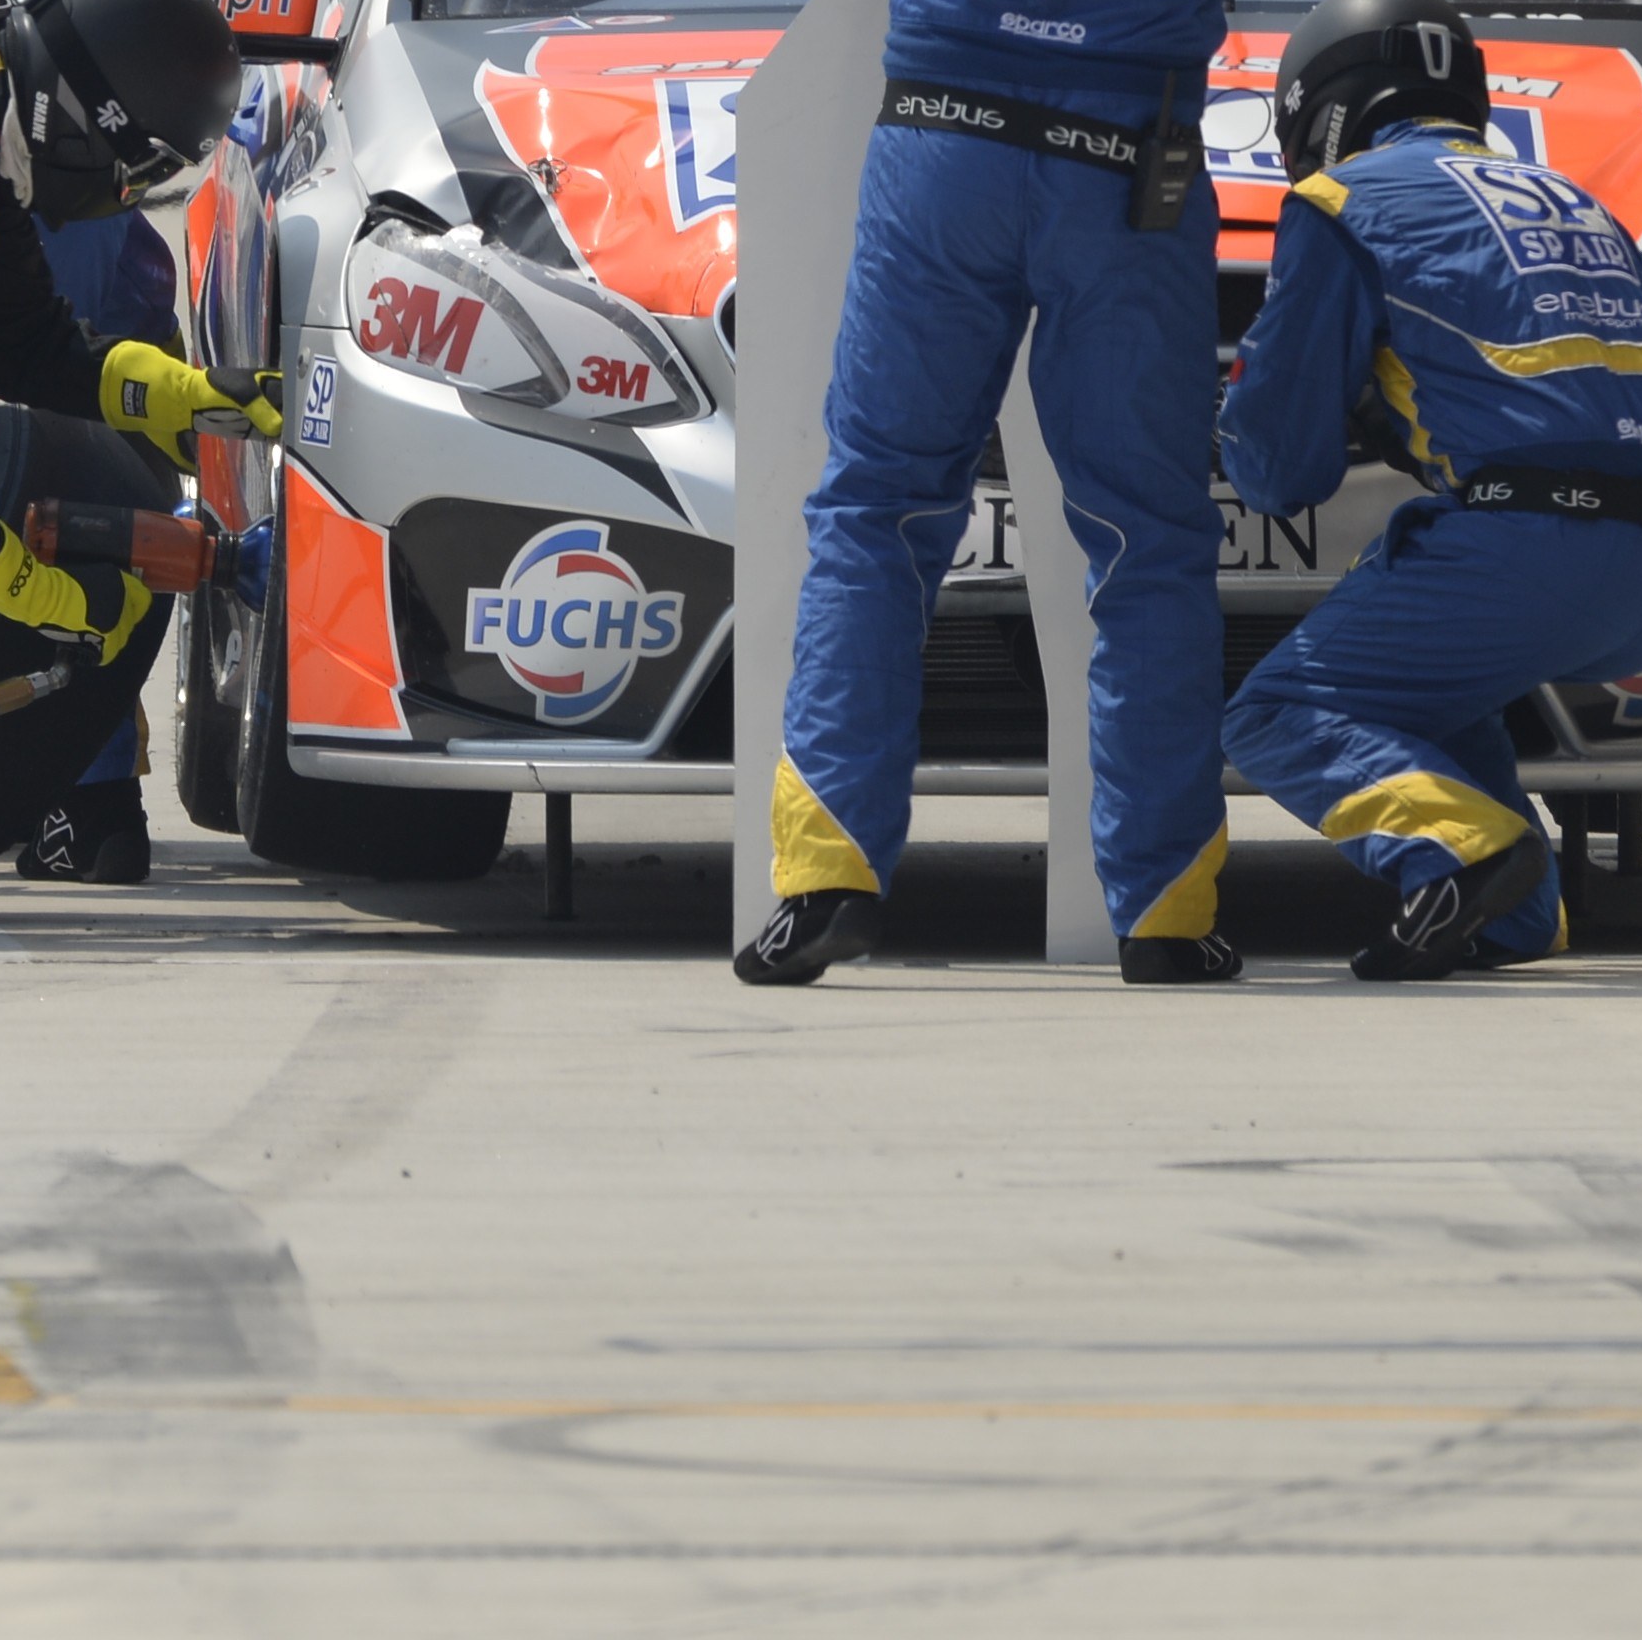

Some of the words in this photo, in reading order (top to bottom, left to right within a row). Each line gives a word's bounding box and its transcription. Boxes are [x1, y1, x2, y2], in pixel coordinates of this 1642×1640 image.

[999, 11, 1087, 42] sparco
[31, 90, 50, 143] SHANE
[895, 94, 1006, 129] erebus
[1474, 166, 1595, 226] SP
[1519, 230, 1565, 261] SP
[359, 276, 485, 376] 3M
[307, 363, 336, 416] SP
[577, 355, 650, 403] 3M
[302, 420, 314, 439] SP
[314, 424, 329, 444] AIR
[471, 597, 678, 650] FUCHS
